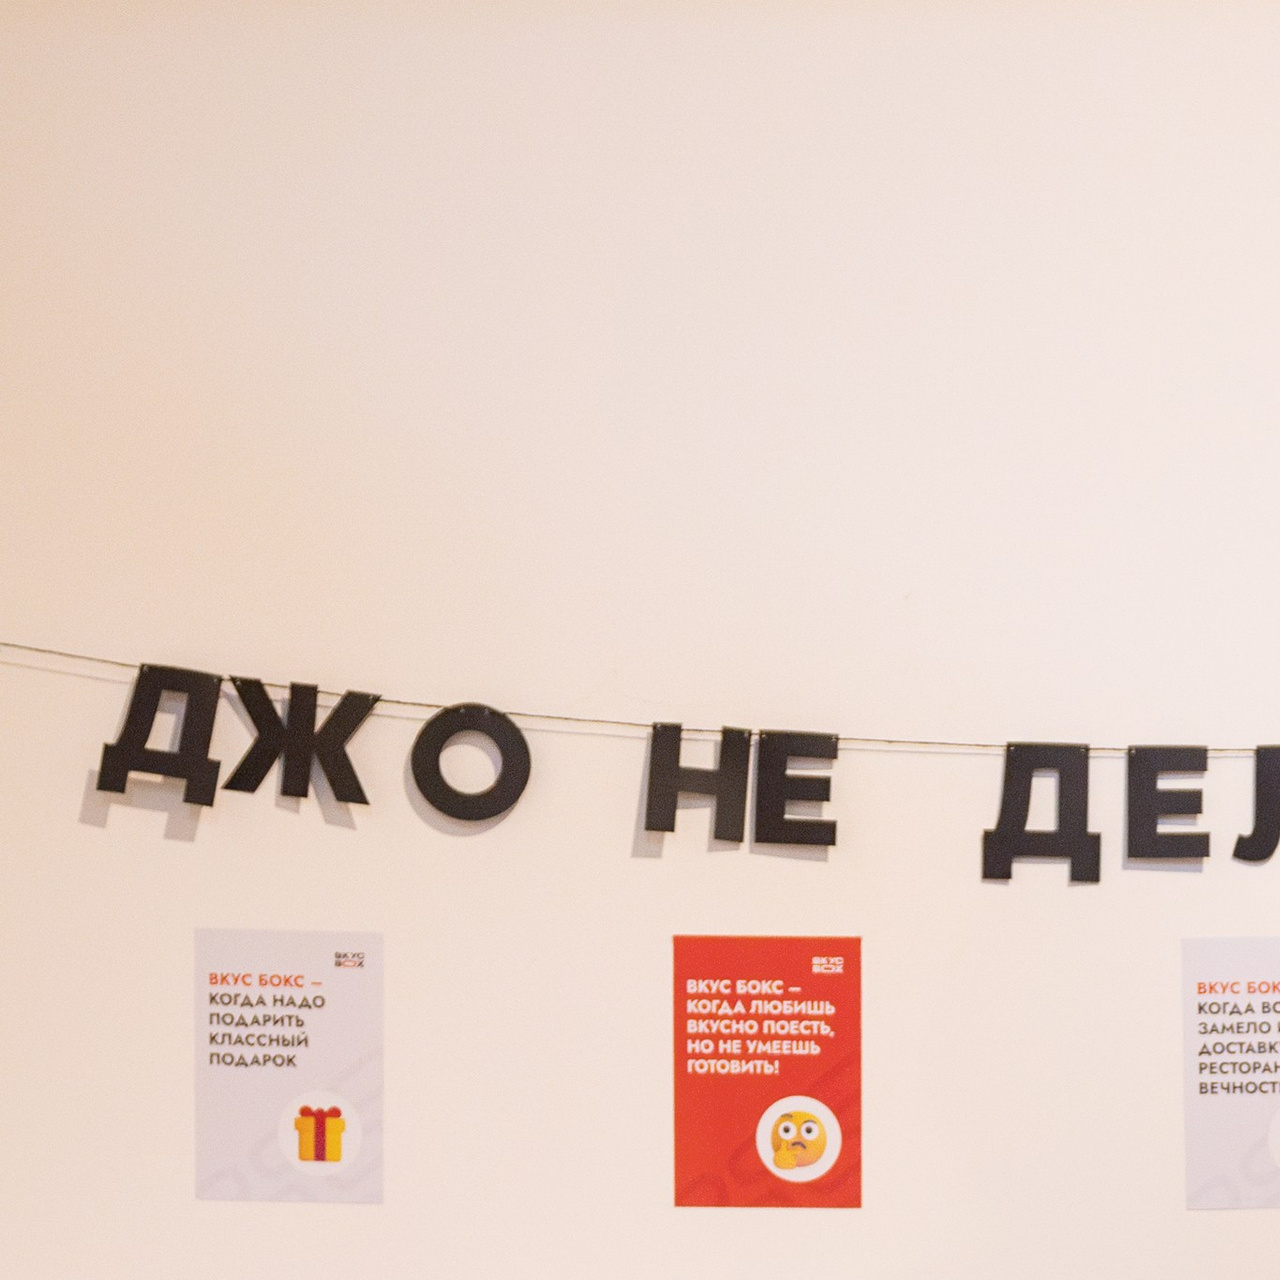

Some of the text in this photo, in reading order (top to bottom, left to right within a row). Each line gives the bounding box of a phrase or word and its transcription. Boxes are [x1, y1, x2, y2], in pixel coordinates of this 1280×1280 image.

[96, 662, 532, 822] ДЖО
[644, 721, 839, 846] НЕ
[209, 973, 251, 985] ВКУС
[259, 974, 304, 987] БОКС
[686, 979, 731, 994] ВКУС
[736, 980, 783, 994] БОКС
[1197, 982, 1240, 994] ВКУС
[209, 993, 326, 1008] КОГДА НАДО
[686, 999, 836, 1015] КОГДА ЛЮБИШЬ
[1198, 1002, 1255, 1015] КОГДА
[209, 1013, 305, 1027] ПОДАРИТЬ
[1199, 1021, 1271, 1034] ЗАМЕЛО
[687, 1019, 835, 1038] ВКУСНО ПОЕСТЬ,
[209, 1032, 308, 1047] КЛАССНЫЙ
[687, 1040, 820, 1055] НО НЕ УМЕЕШЬ
[209, 1052, 297, 1067] ПОДАРОК
[687, 1059, 779, 1075] ГОТОВИТЬ!
